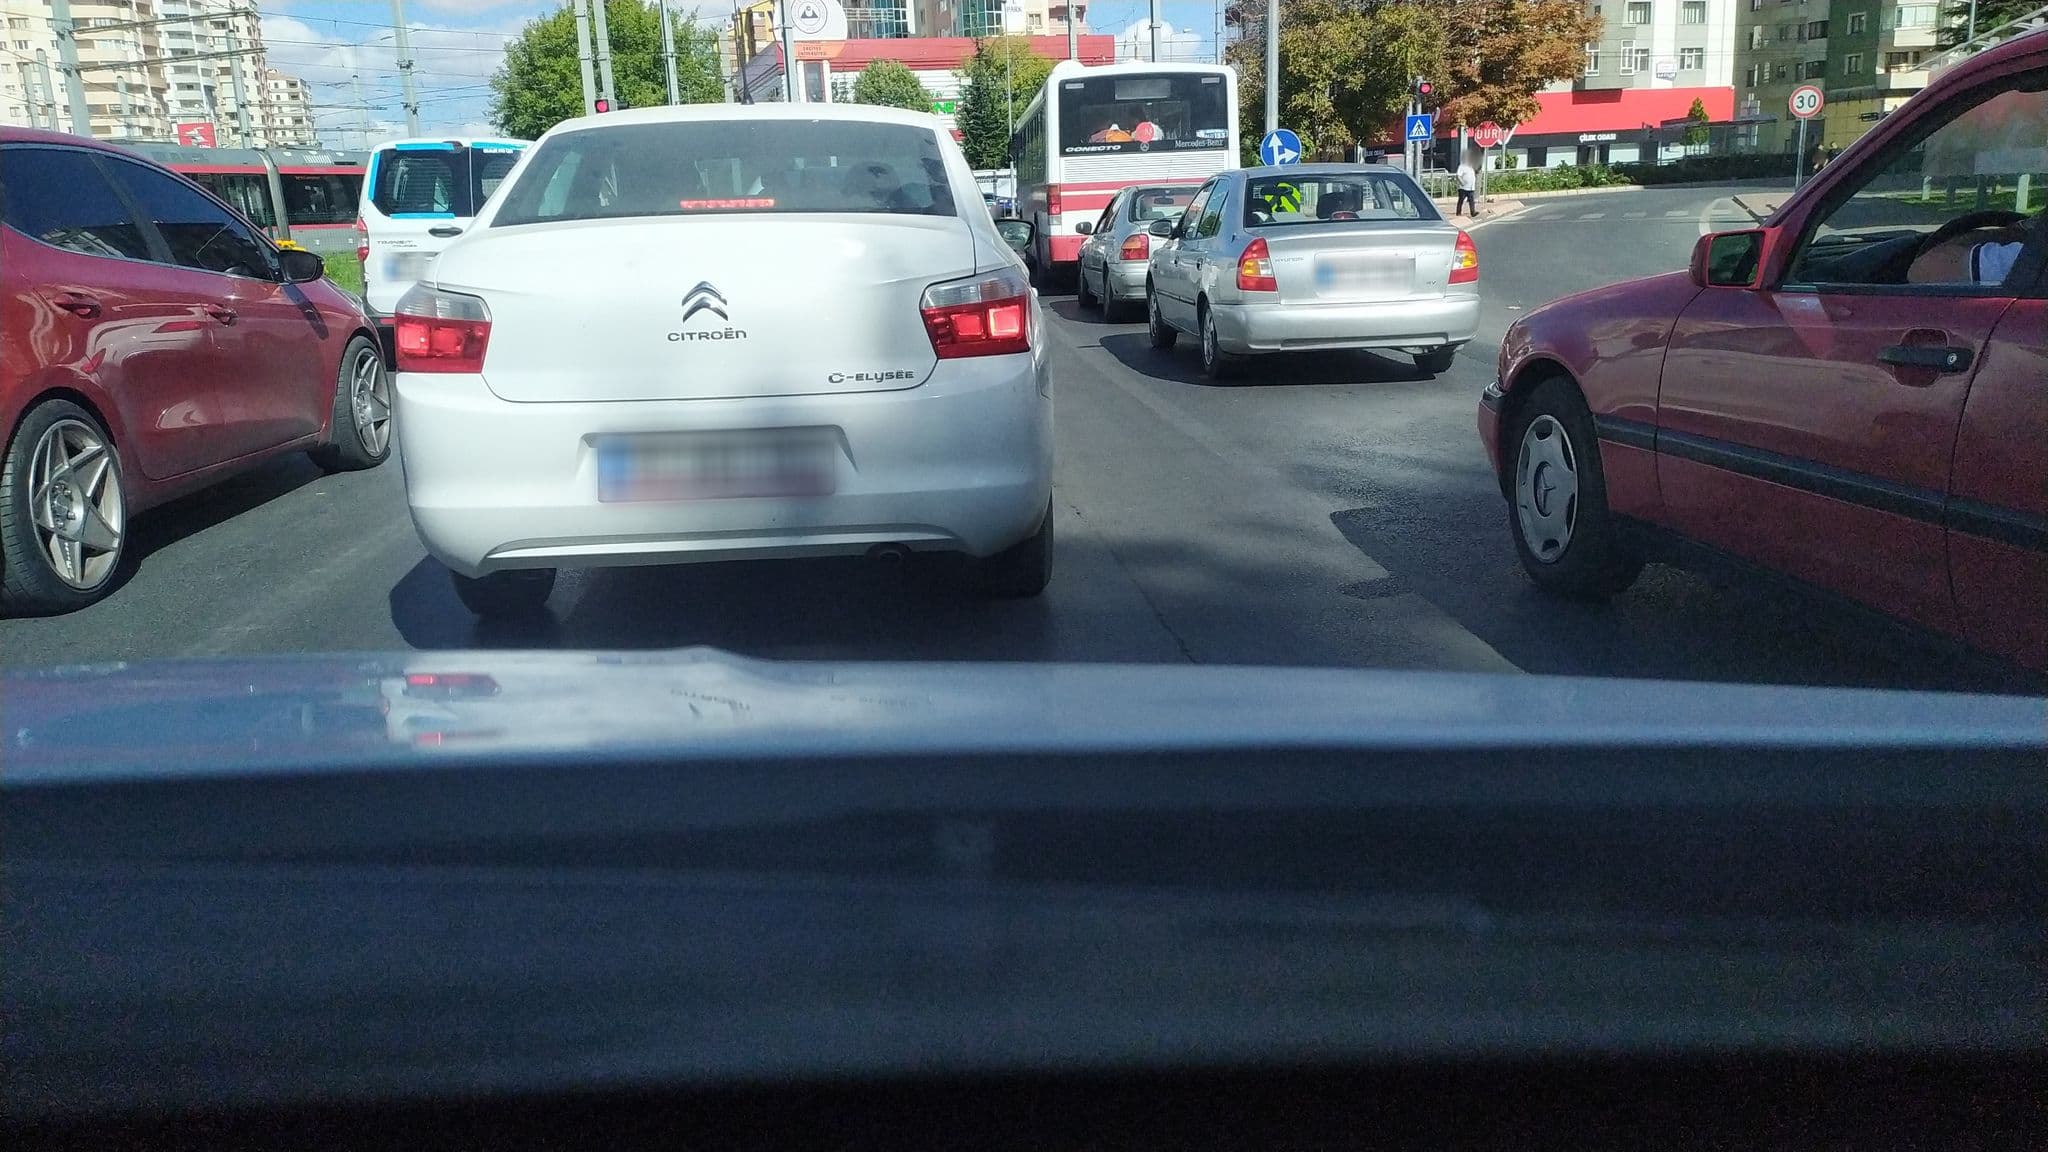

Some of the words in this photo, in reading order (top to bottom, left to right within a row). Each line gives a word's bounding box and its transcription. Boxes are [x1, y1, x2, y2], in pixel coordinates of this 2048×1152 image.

[1796, 94, 1817, 109] 30
[1476, 129, 1498, 140] DUR
[1579, 133, 1597, 143] ÇİLEK
[1597, 133, 1617, 141] ODASI
[1174, 138, 1224, 148] Mercedes-Benz
[1065, 145, 1122, 153] CONECTO
[667, 327, 748, 342] CITROËN
[827, 370, 915, 384] C-ELYSÉE
